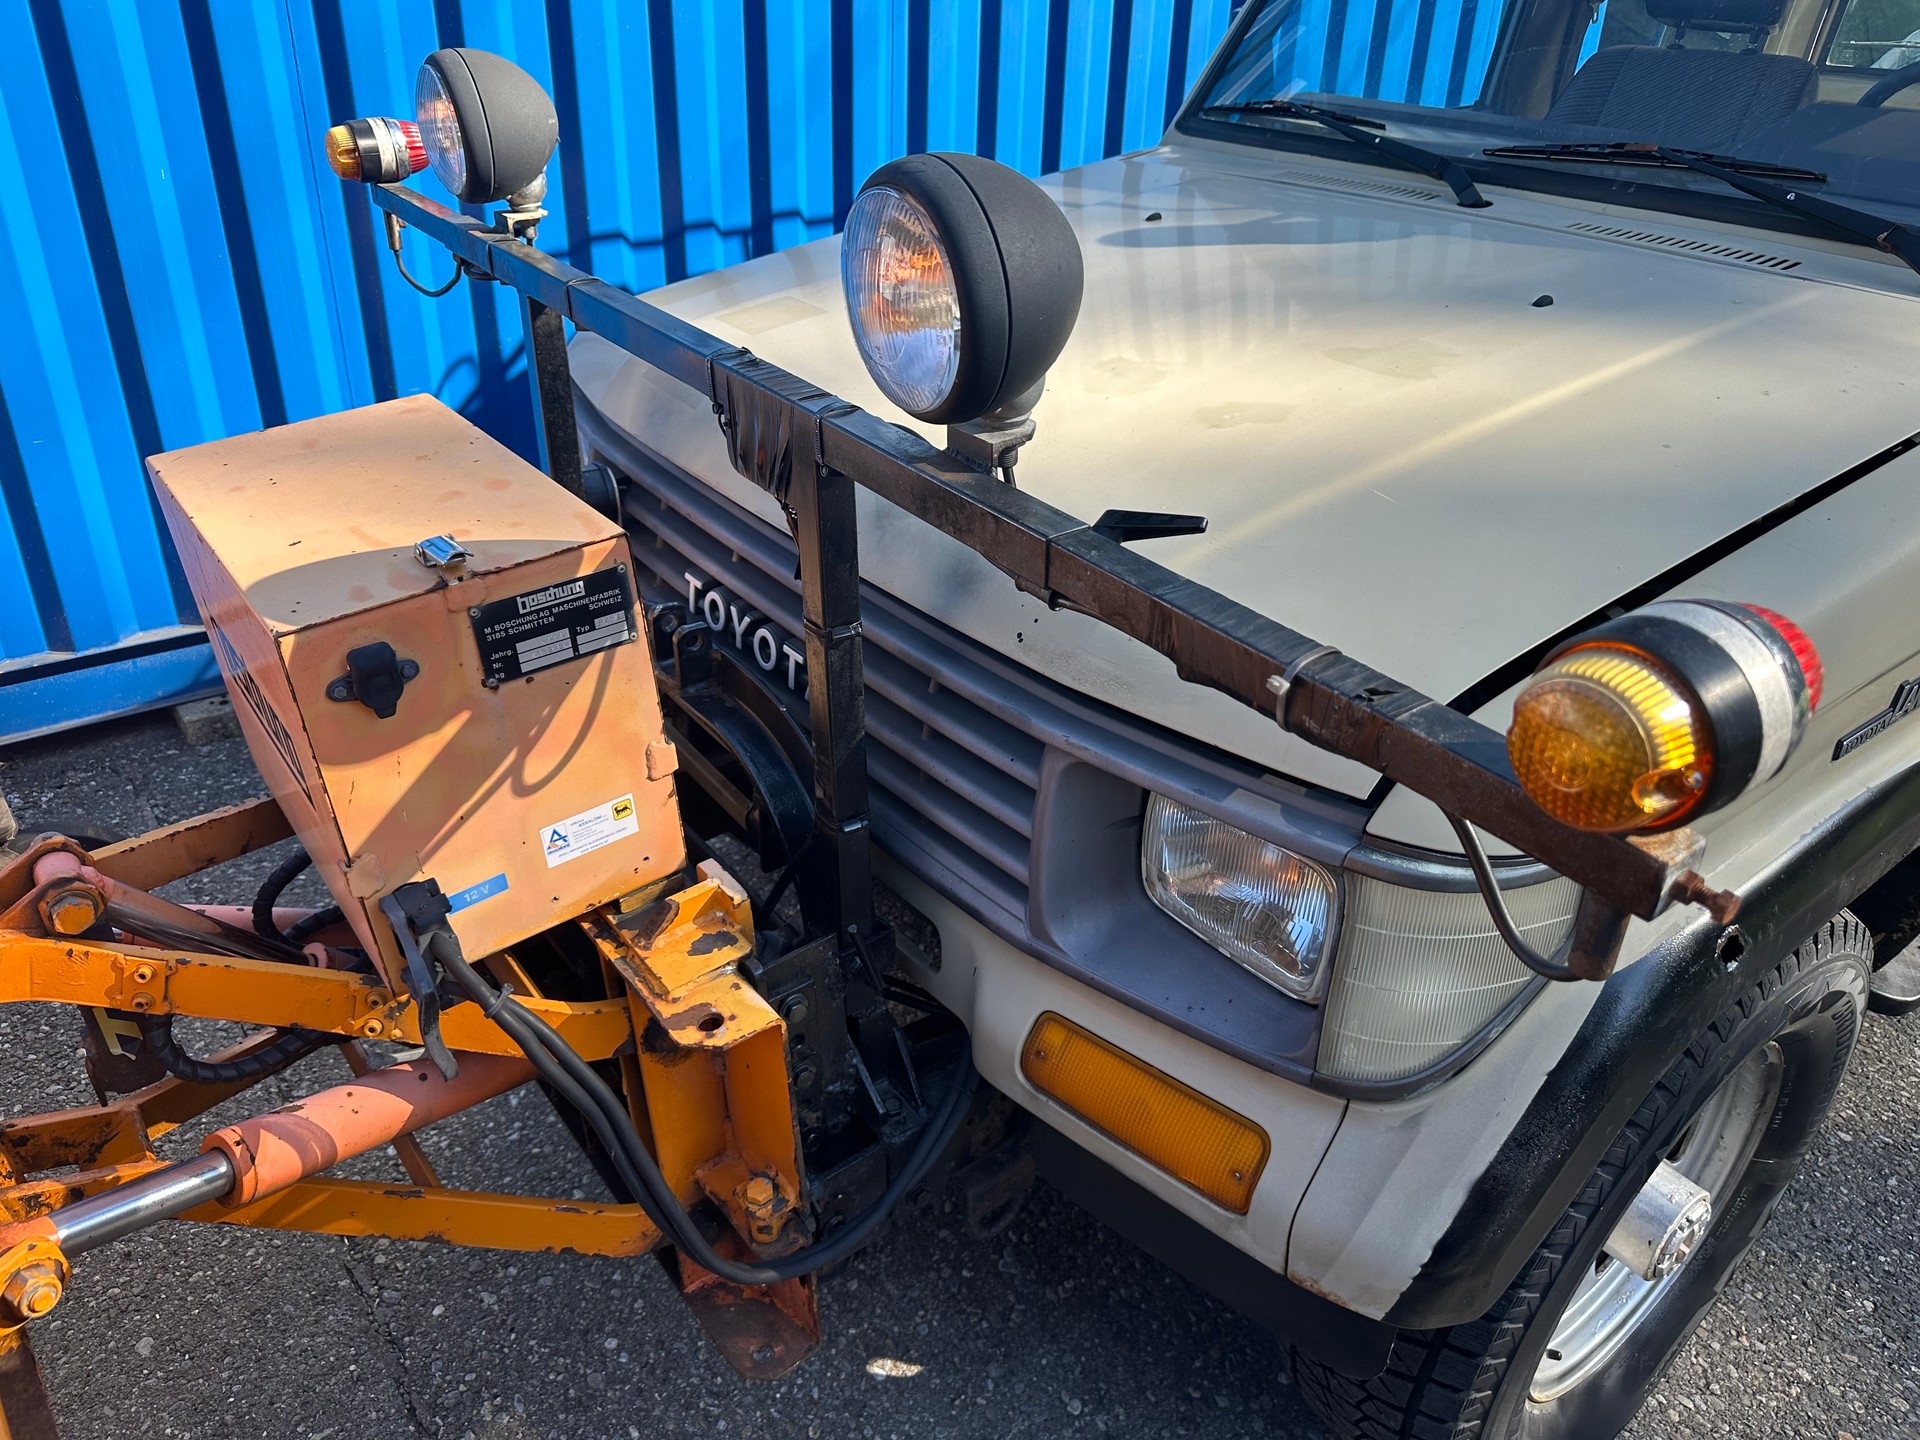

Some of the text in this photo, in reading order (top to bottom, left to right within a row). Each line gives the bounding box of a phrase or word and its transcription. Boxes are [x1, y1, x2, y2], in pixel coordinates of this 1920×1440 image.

[539, 609, 550, 618] AG
[552, 588, 621, 614] MASCHINENFABRIK
[486, 630, 506, 642] 3185
[508, 615, 555, 635] SCHMITTEN
[588, 595, 623, 610] SCHWEIZ
[576, 625, 590, 633] Typ
[684, 571, 809, 699] TOYOT
[490, 649, 514, 660] Jahrg.
[463, 884, 490, 902] 12 V
